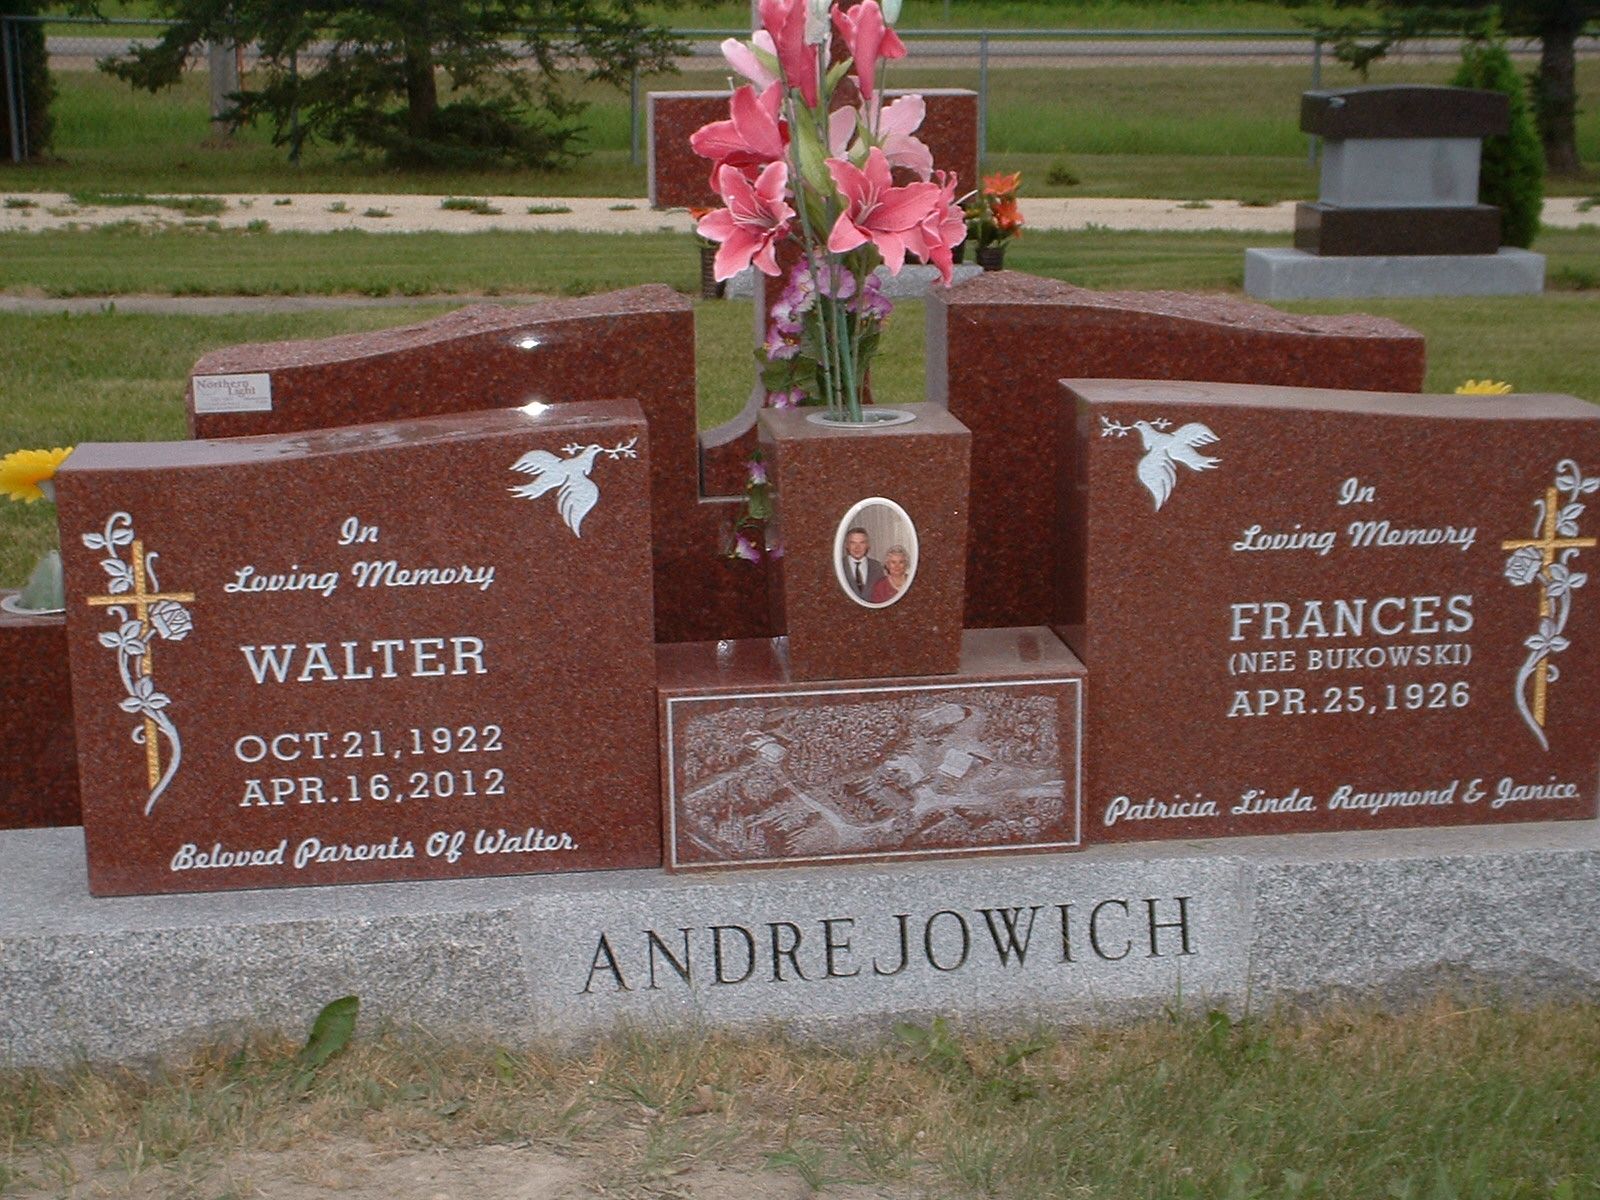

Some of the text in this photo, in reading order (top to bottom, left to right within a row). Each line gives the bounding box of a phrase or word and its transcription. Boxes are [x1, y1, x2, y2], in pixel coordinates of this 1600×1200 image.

[197, 380, 249, 389] Northern
[228, 386, 256, 397] Light
[1337, 477, 1375, 505] In
[338, 516, 378, 545] In
[1232, 521, 1477, 556] Loving Memory
[224, 560, 495, 597] Loving Memory
[1229, 594, 1475, 641] FRANCES
[240, 636, 488, 684] WALTER
[1227, 643, 1473, 676] (NEE BUKOWSKI)
[1463, 778, 1486, 804] &
[170, 839, 288, 871] Beloved
[294, 837, 415, 869] Parents
[425, 830, 467, 863] Of
[577, 896, 1196, 995] ANDREJOWICH
